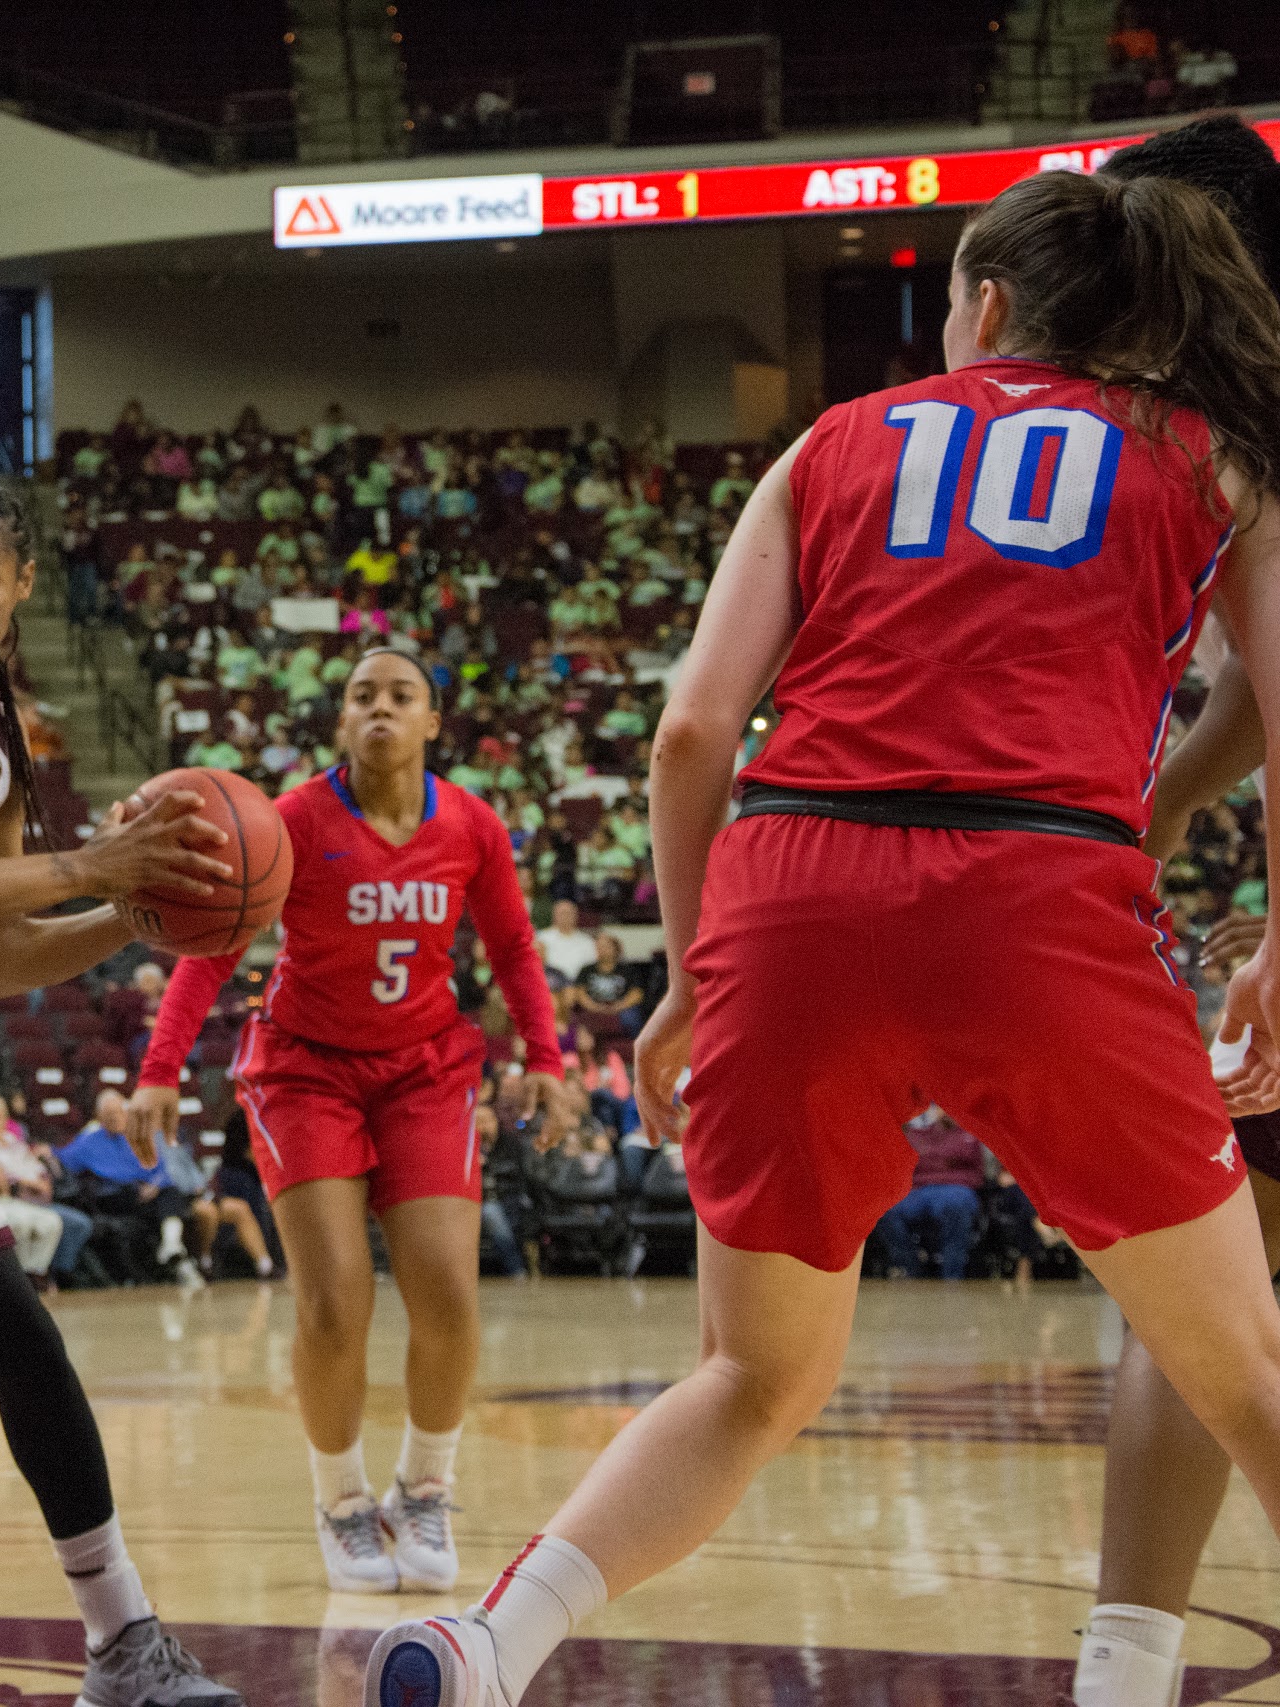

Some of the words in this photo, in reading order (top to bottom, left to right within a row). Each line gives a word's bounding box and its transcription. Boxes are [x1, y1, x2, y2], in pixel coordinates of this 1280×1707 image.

[353, 200, 449, 227] Moore
[457, 188, 530, 224] Feed
[572, 181, 660, 220] STL:
[676, 171, 700, 219] 1
[802, 166, 897, 208] AST:
[905, 157, 941, 205] 8
[883, 399, 1125, 570] 10
[346, 880, 449, 925] SMU
[370, 938, 420, 1005] 5
